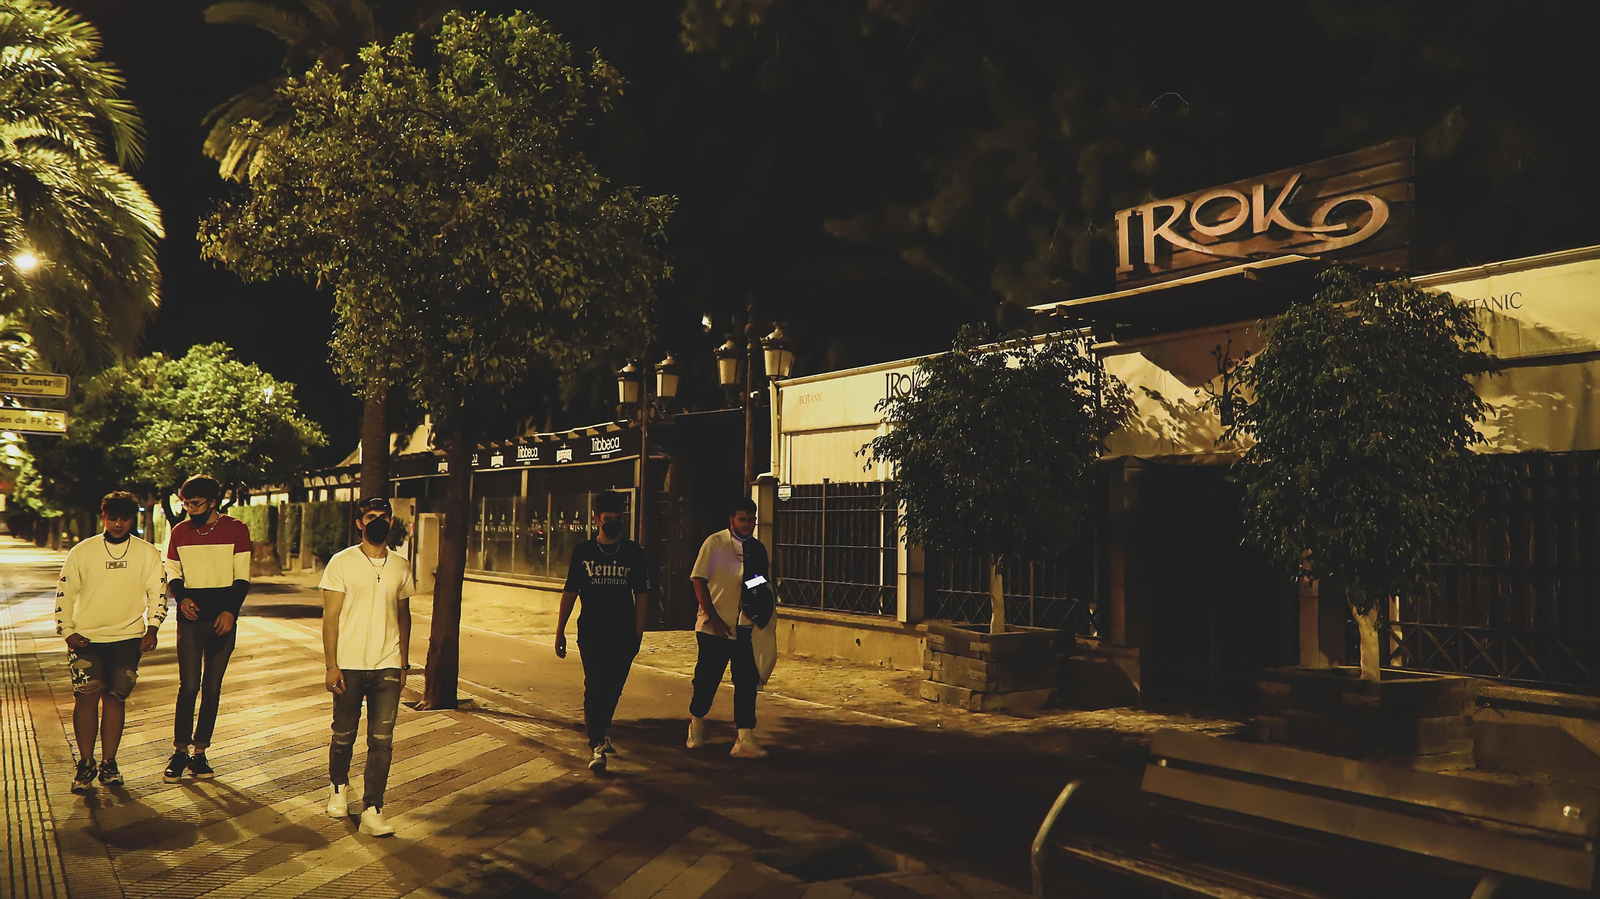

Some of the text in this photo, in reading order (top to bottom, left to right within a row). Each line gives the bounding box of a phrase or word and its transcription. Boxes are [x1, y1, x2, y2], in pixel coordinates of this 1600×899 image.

[1115, 172, 1390, 273] IROKO
[1457, 291, 1523, 314] OTANIC
[799, 392, 823, 405] BOTANIC
[15, 416, 27, 424] de
[591, 436, 620, 452] Tribbeca
[581, 560, 631, 577] Venice
